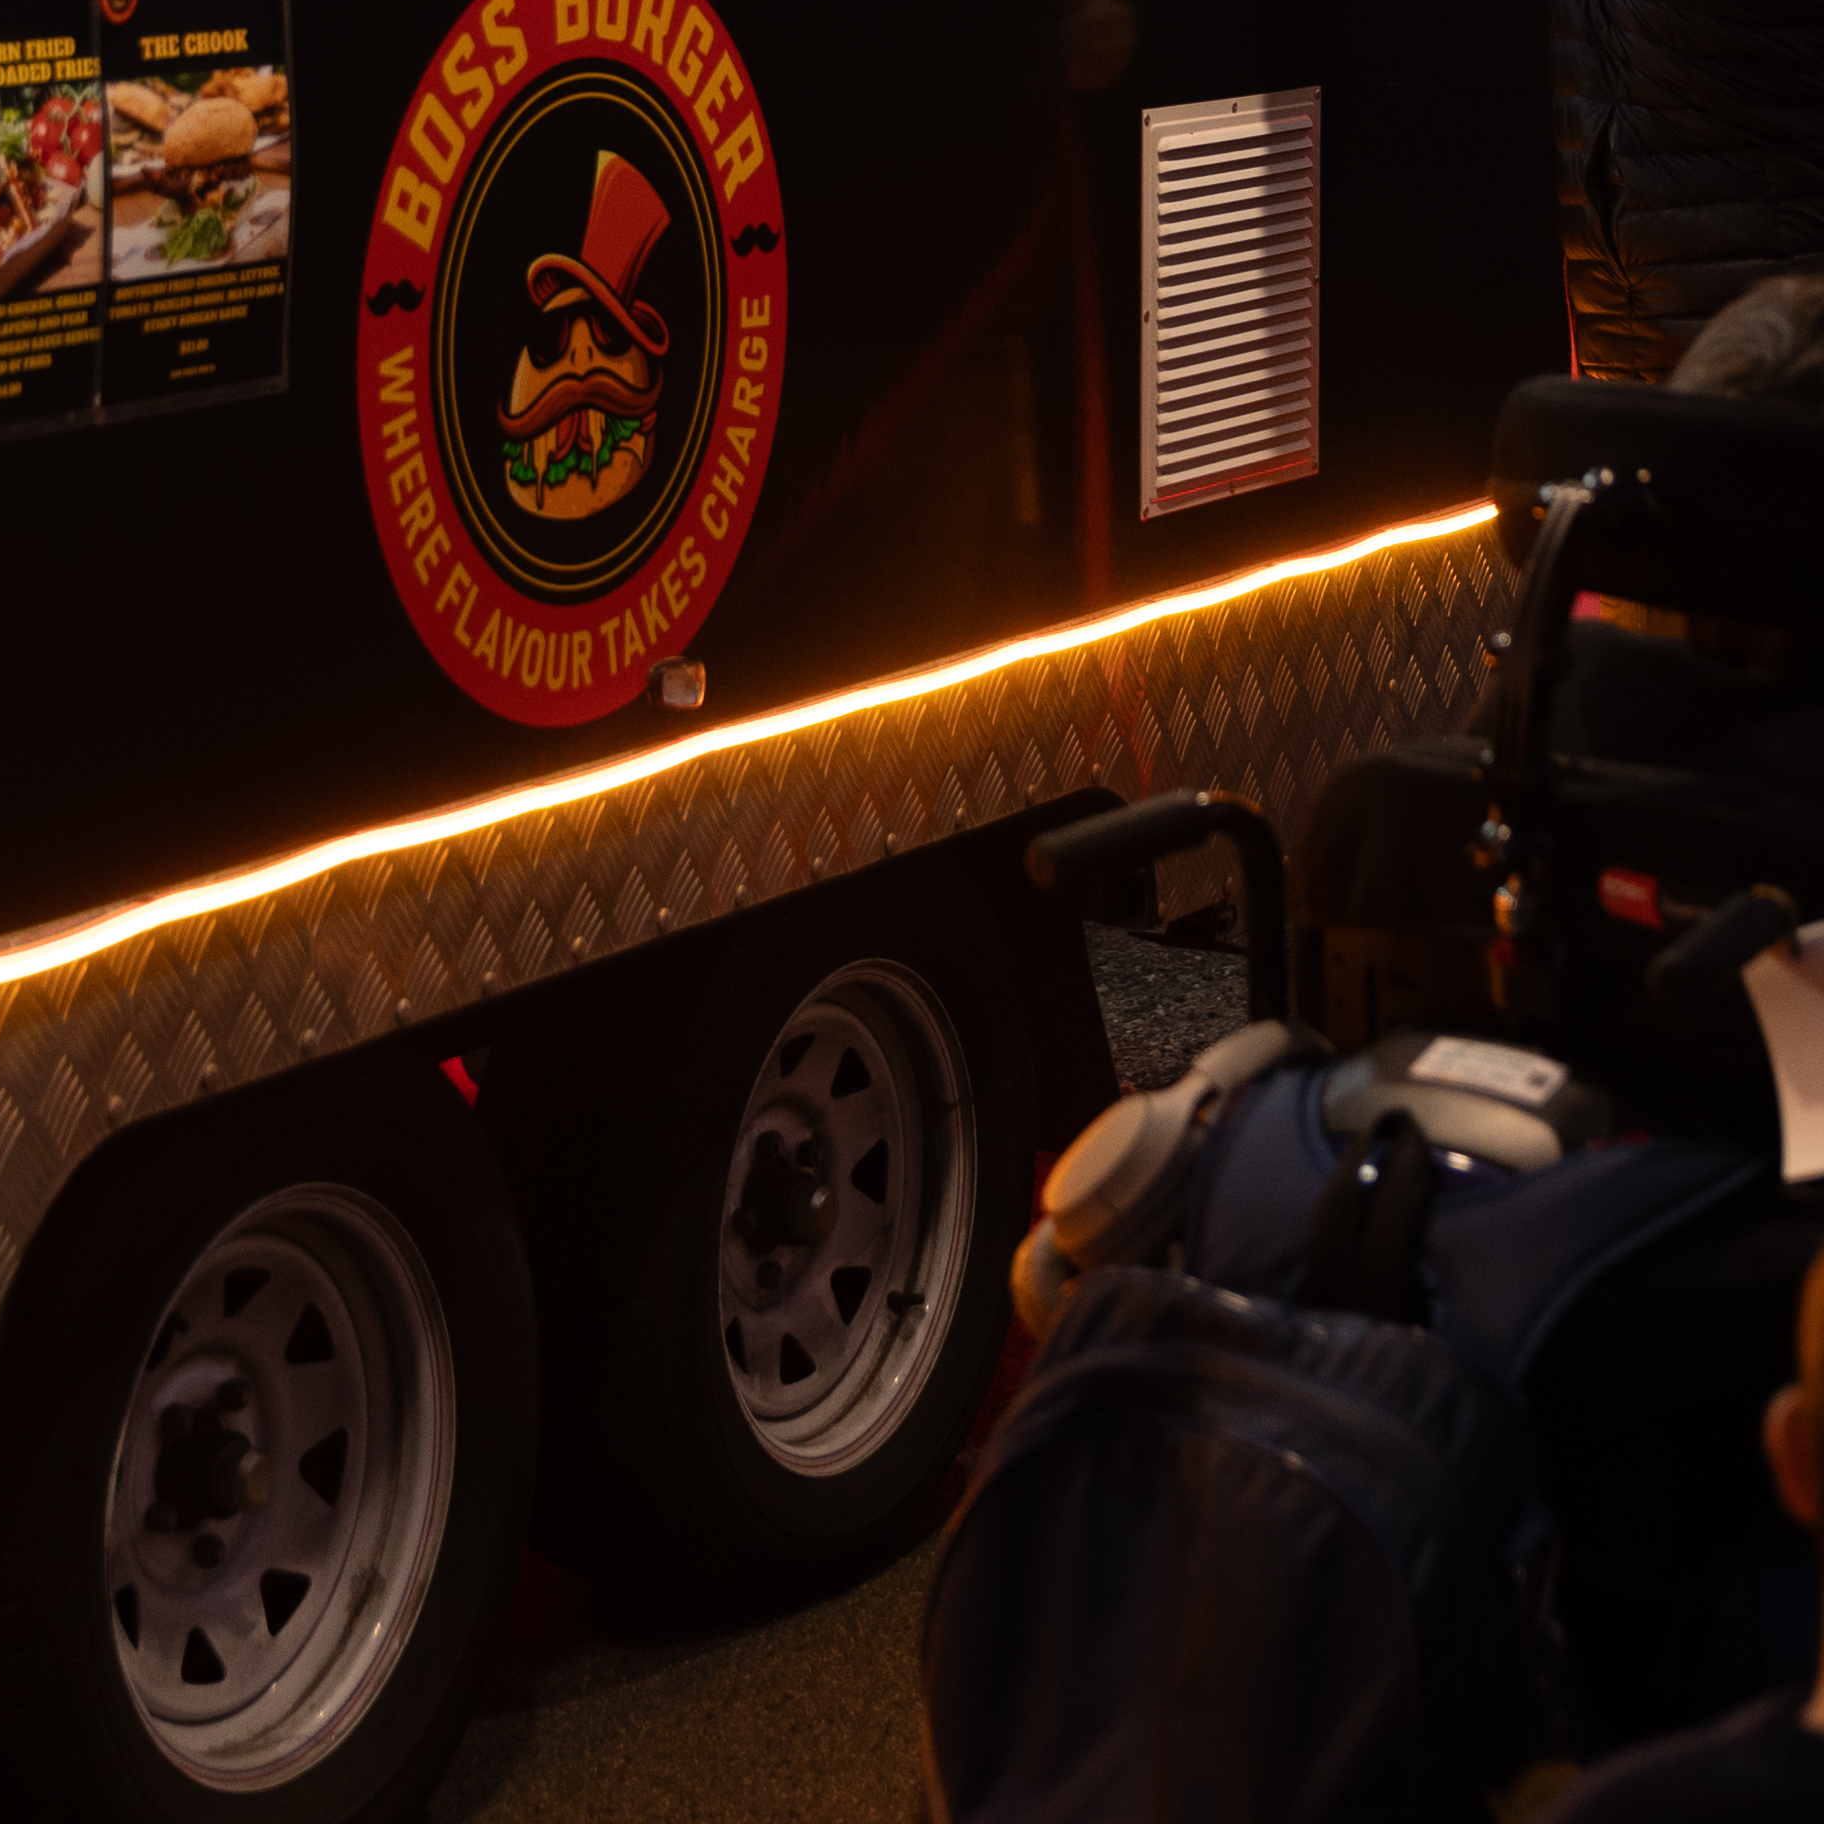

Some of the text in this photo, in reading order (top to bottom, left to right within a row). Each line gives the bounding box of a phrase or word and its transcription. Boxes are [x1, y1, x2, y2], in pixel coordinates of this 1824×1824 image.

[24, 35, 76, 62] FRIED
[139, 29, 249, 61] THE CHOOK
[54, 56, 101, 82] FRIES
[55, 290, 97, 310] GRILLED
[114, 277, 195, 302] SOUTHERN FRIED
[153, 295, 192, 314] PICKLED
[226, 285, 255, 303] MAYO
[256, 282, 276, 298] AND
[38, 314, 61, 332] AND
[178, 309, 218, 329] KOREAN
[219, 304, 248, 322] SAUCE
[31, 332, 64, 352] SAUCE
[380, 293, 772, 691] WHERE FLAVOUR TAKES CHARGE
